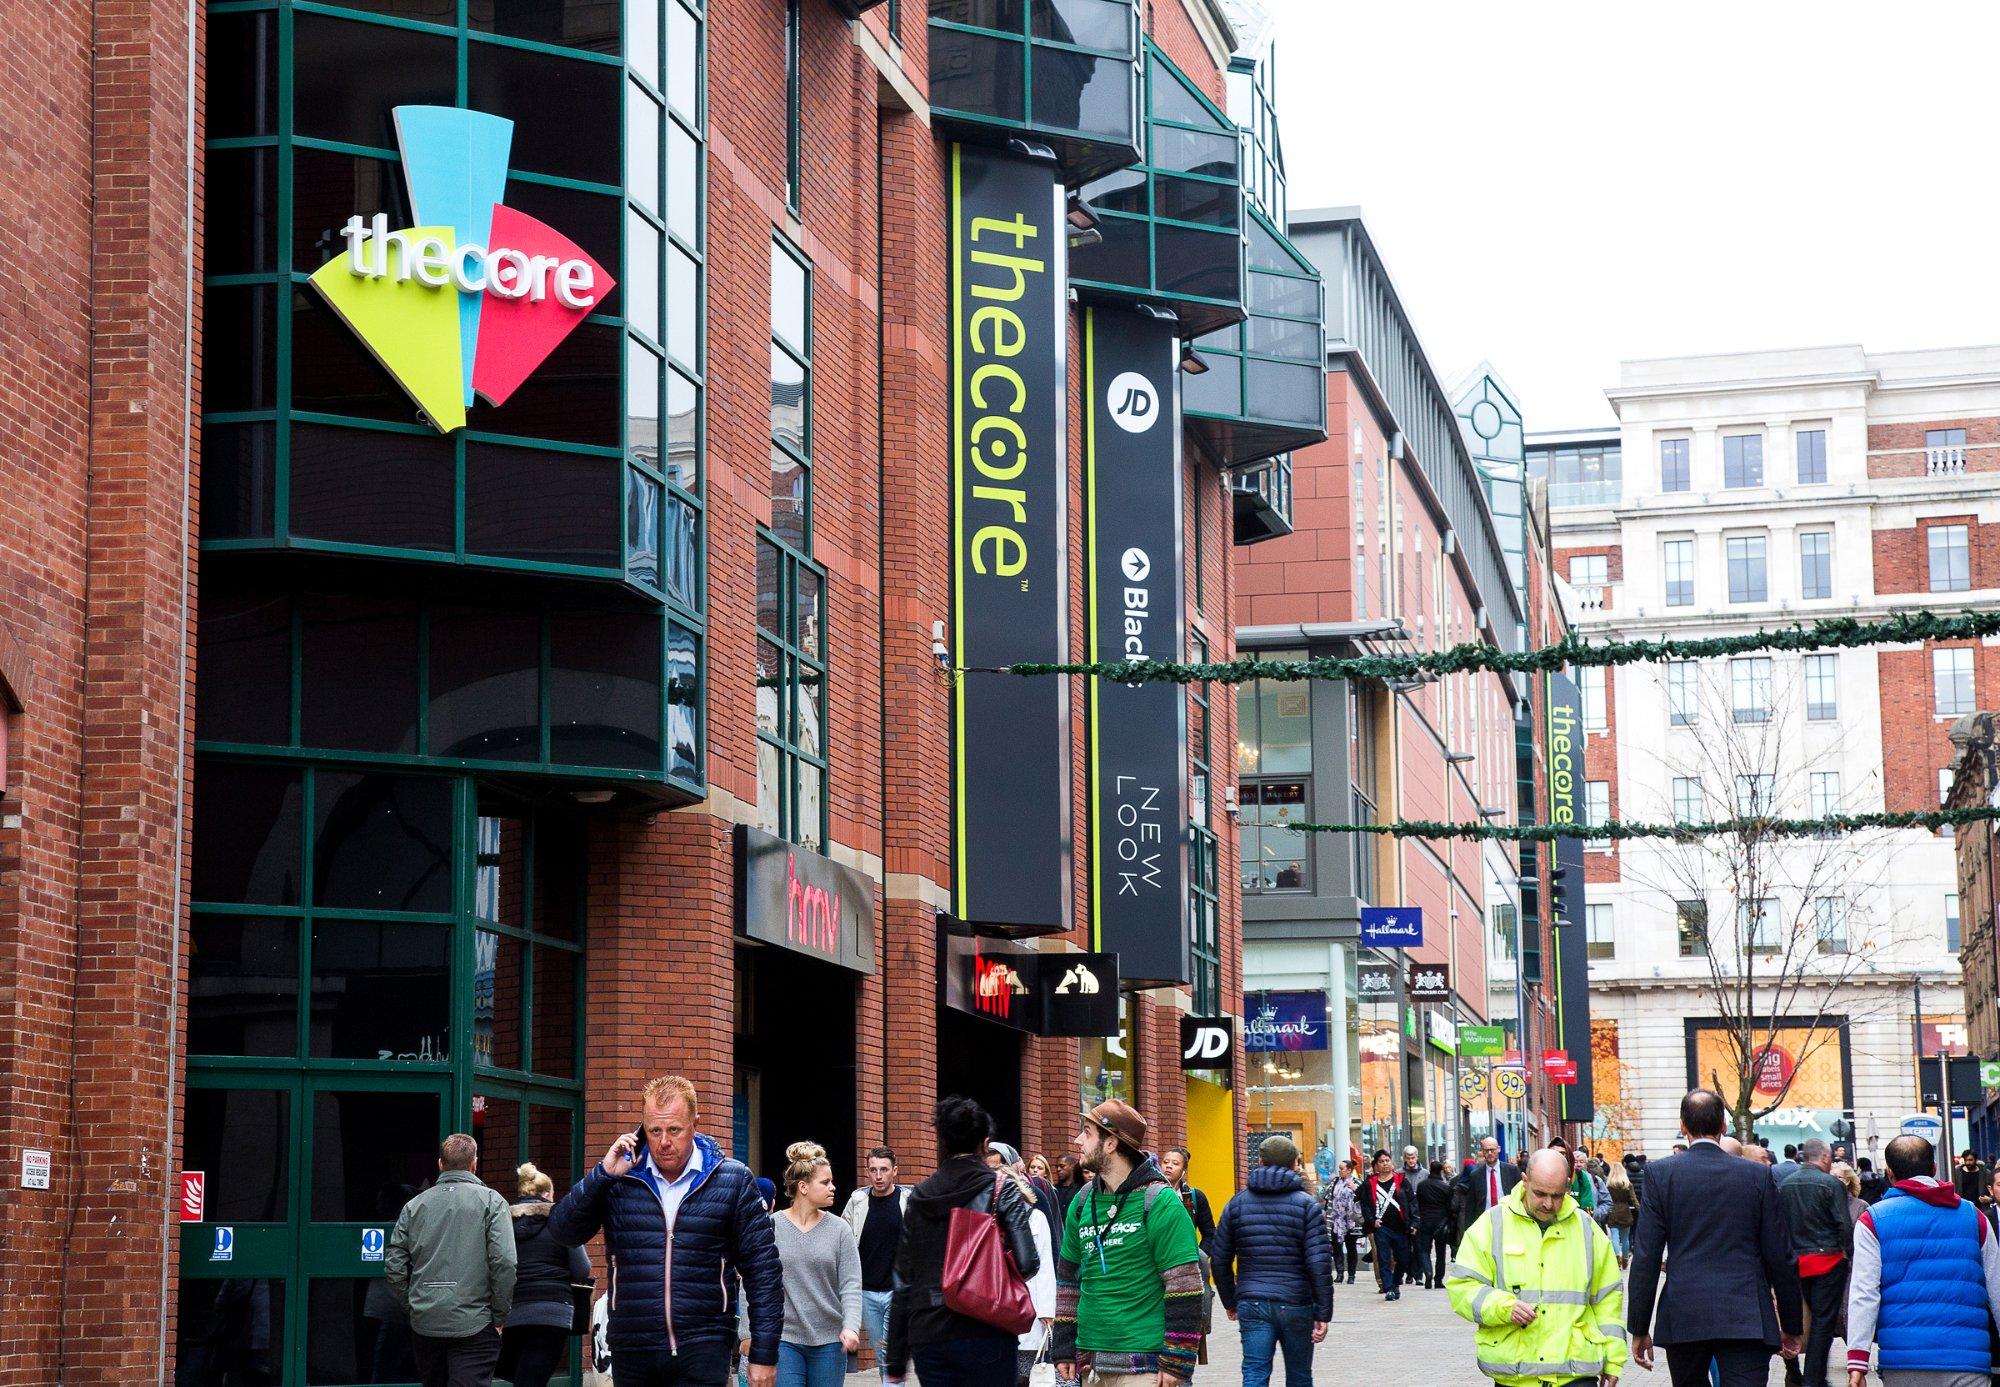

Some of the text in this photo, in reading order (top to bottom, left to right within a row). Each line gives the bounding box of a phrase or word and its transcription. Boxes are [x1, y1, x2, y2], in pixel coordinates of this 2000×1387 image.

[340, 213, 594, 310] thecore
[969, 213, 1045, 577] thecore
[1117, 388, 1152, 417] JD
[1553, 704, 1576, 824] thecore
[1117, 776, 1138, 896] LOOK
[1140, 787, 1161, 888] NEW
[788, 852, 839, 954] hmv
[1365, 923, 1419, 939] Hallmark
[1244, 1015, 1318, 1036] allmark
[1464, 1036, 1498, 1044] Waitrose
[1184, 1027, 1229, 1060] JD
[1760, 1073, 1781, 1081] small
[1760, 1081, 1782, 1089] prices
[1103, 1238, 1123, 1246] HERE
